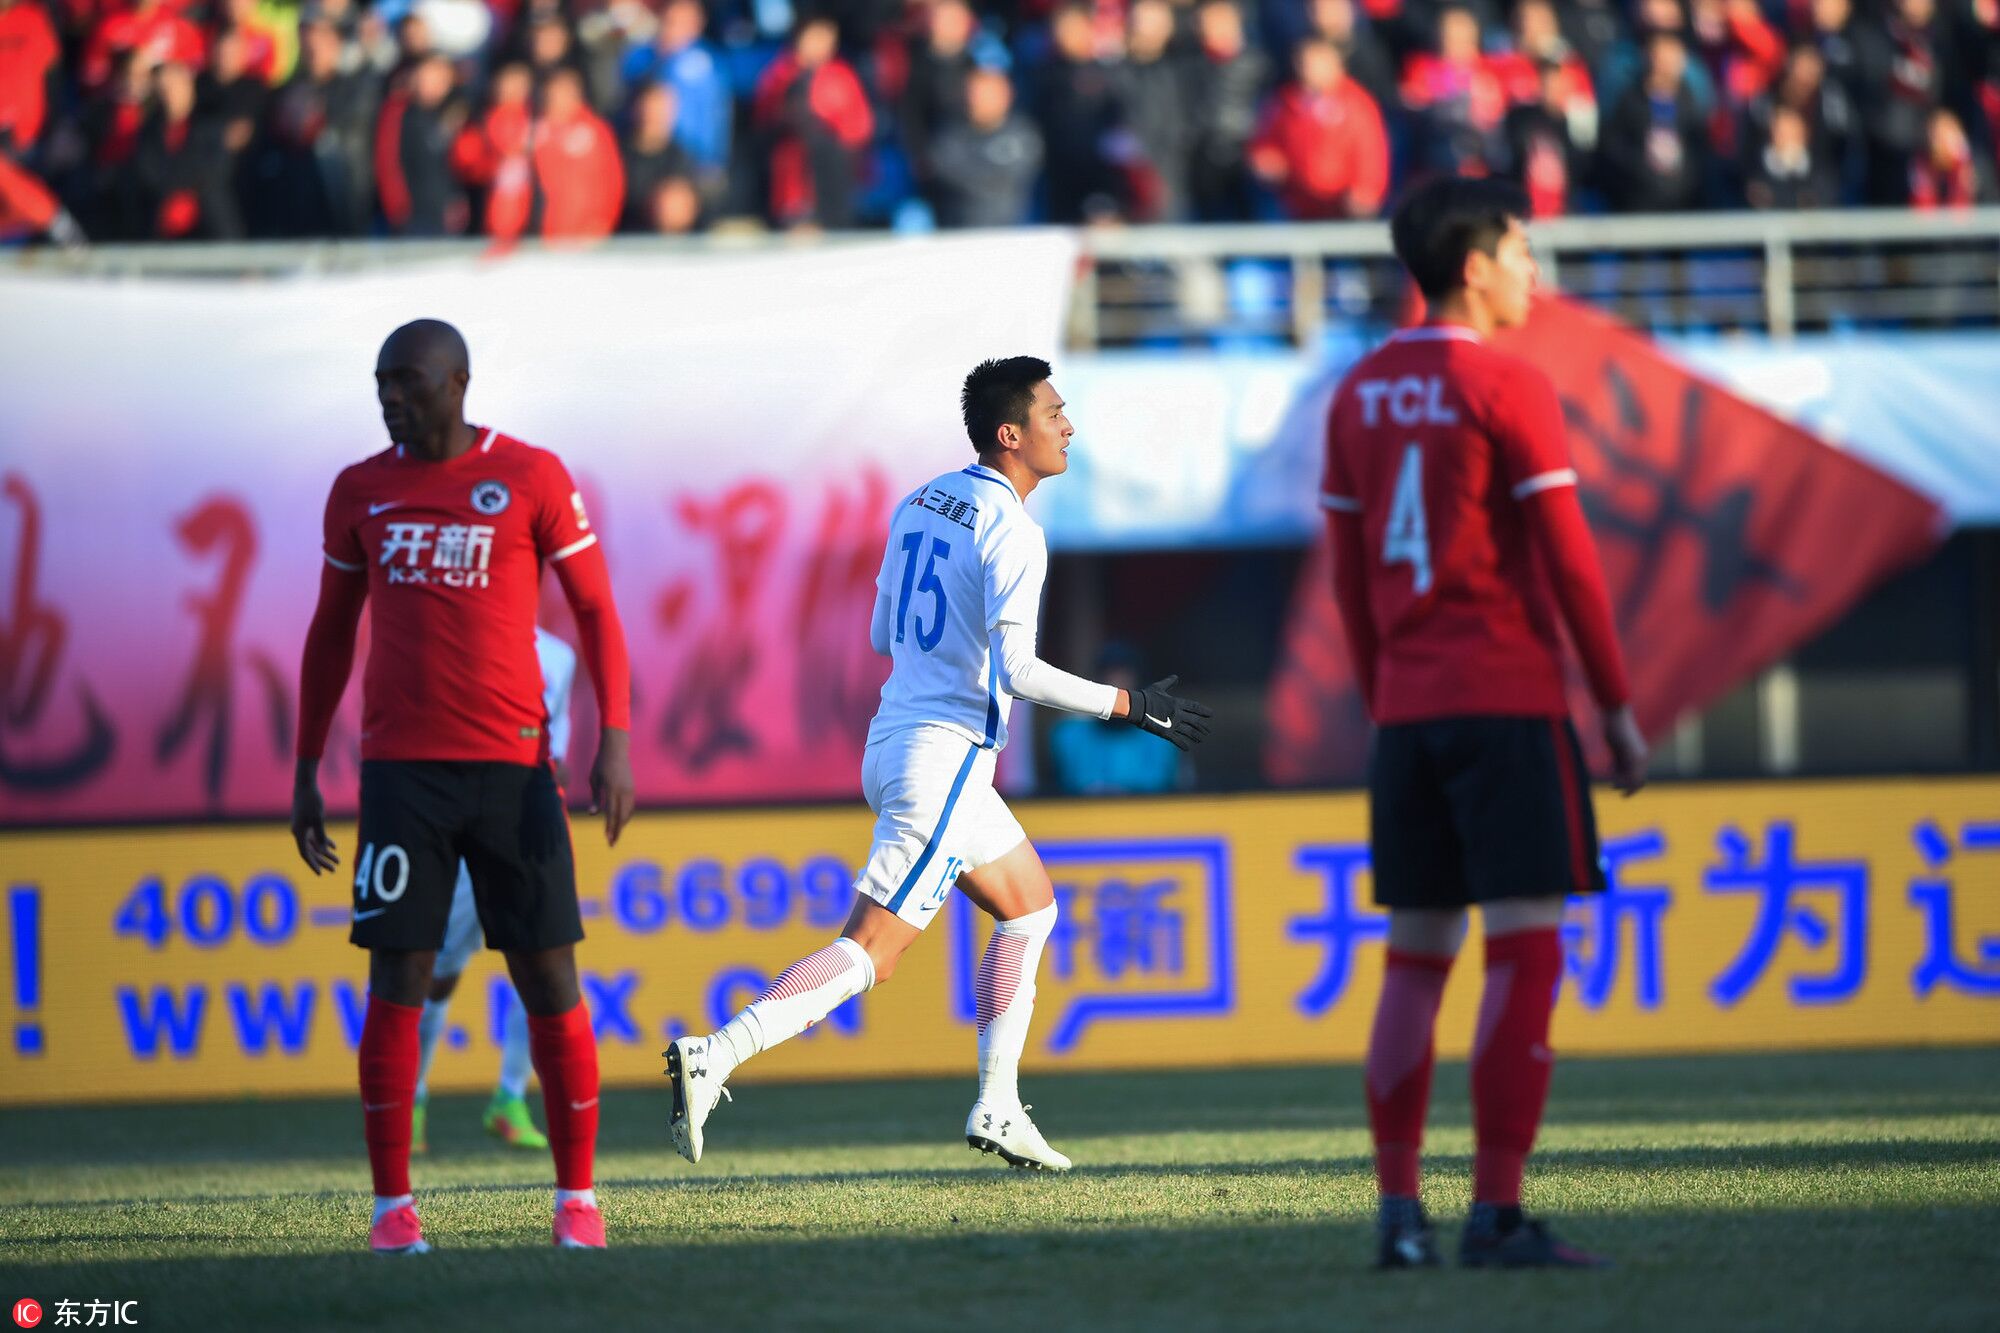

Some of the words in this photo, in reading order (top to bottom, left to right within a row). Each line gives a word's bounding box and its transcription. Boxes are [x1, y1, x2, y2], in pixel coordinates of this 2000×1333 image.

[1356, 375, 1459, 427] TCL
[924, 489, 979, 531] 三菱重工
[1383, 442, 1433, 594] 4
[379, 521, 496, 570] 开新
[895, 531, 951, 653] 15
[355, 841, 410, 903] 40
[932, 856, 964, 902] 15
